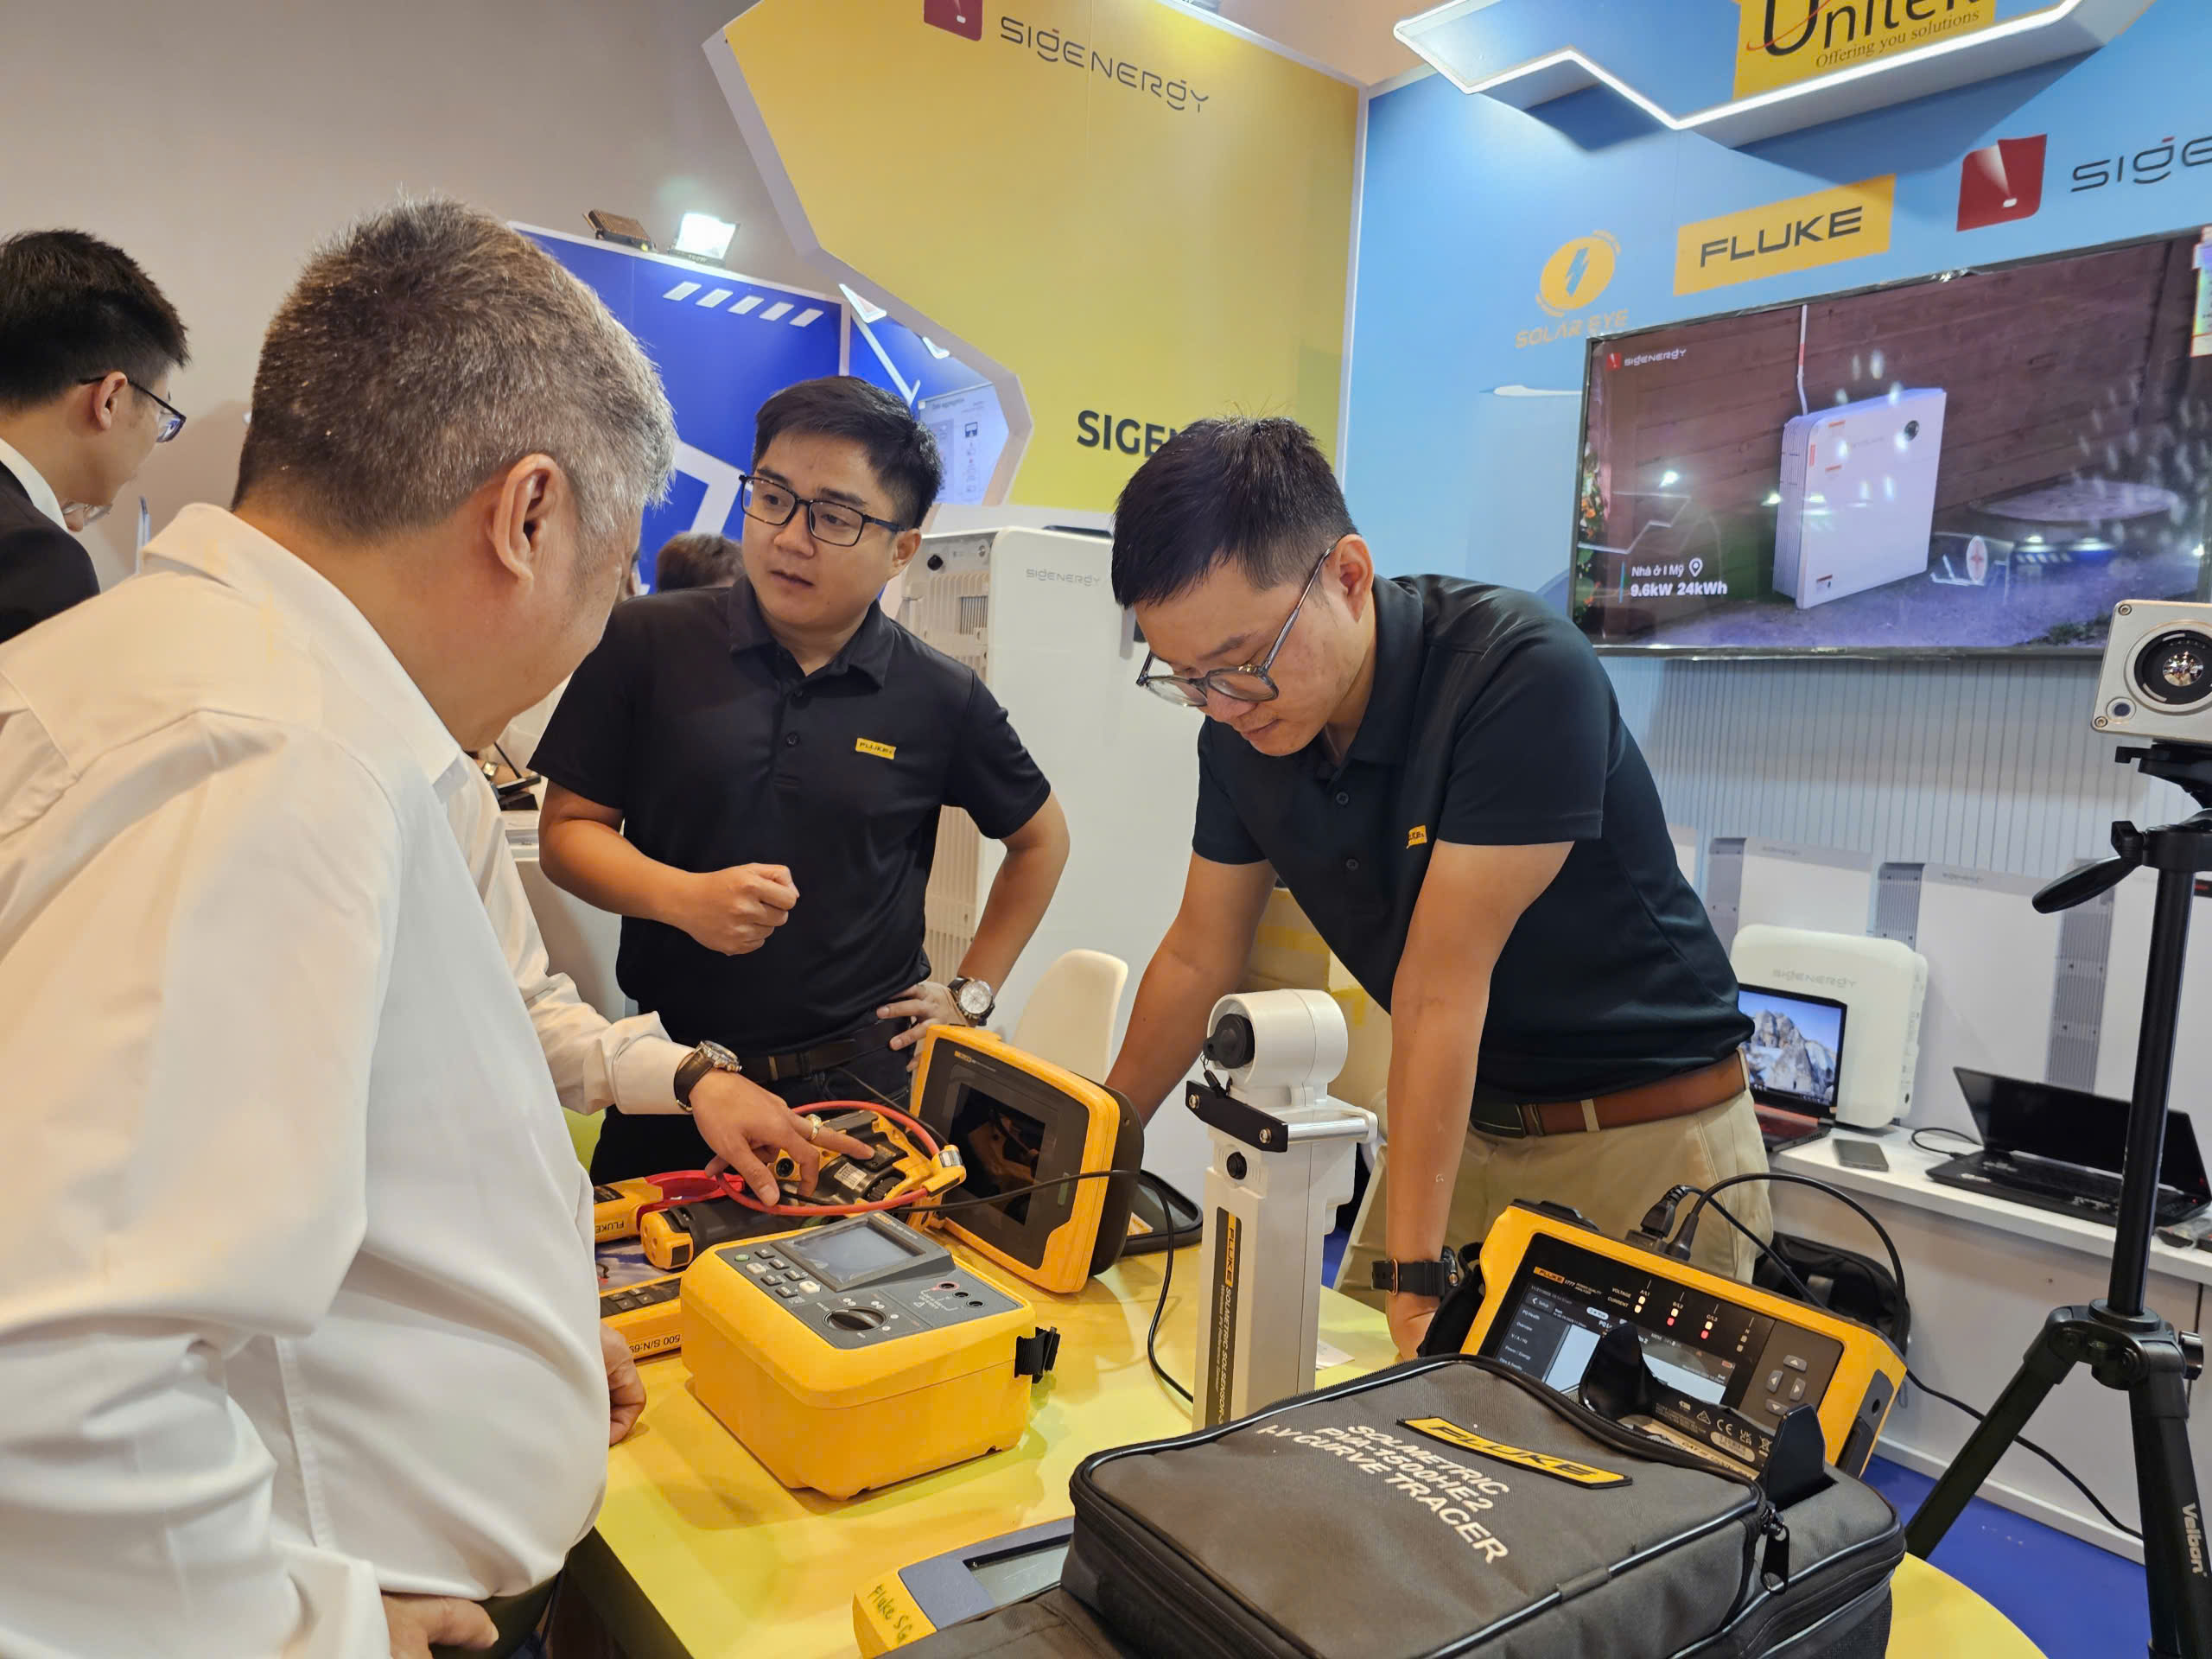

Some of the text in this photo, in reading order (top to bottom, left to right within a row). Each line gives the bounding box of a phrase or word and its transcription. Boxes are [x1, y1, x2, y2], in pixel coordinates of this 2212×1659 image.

[1000, 16, 1210, 112] SIGENERGY
[1815, 10, 1980, 69] Offering you solutions
[1700, 206, 1863, 268] FLUKE
[1514, 308, 1629, 349] SOLAR EYE
[1077, 410, 1178, 458] SIGE
[1630, 580, 1728, 597] 9.6kW 24kWh
[594, 1220, 625, 1234] FLUKE
[1222, 1286, 1231, 1351] SOLMETRIC
[1607, 1296, 1630, 1308] CURRENT
[1314, 1427, 1495, 1514] PVA-1500HE2
[1347, 1424, 1510, 1497] SOLMETRIC
[1427, 1425, 1599, 1477] FLUKE
[1293, 1433, 1385, 1475] CURVE
[1384, 1471, 1510, 1565] TRACER
[2182, 1503, 2204, 1574] Velbon
